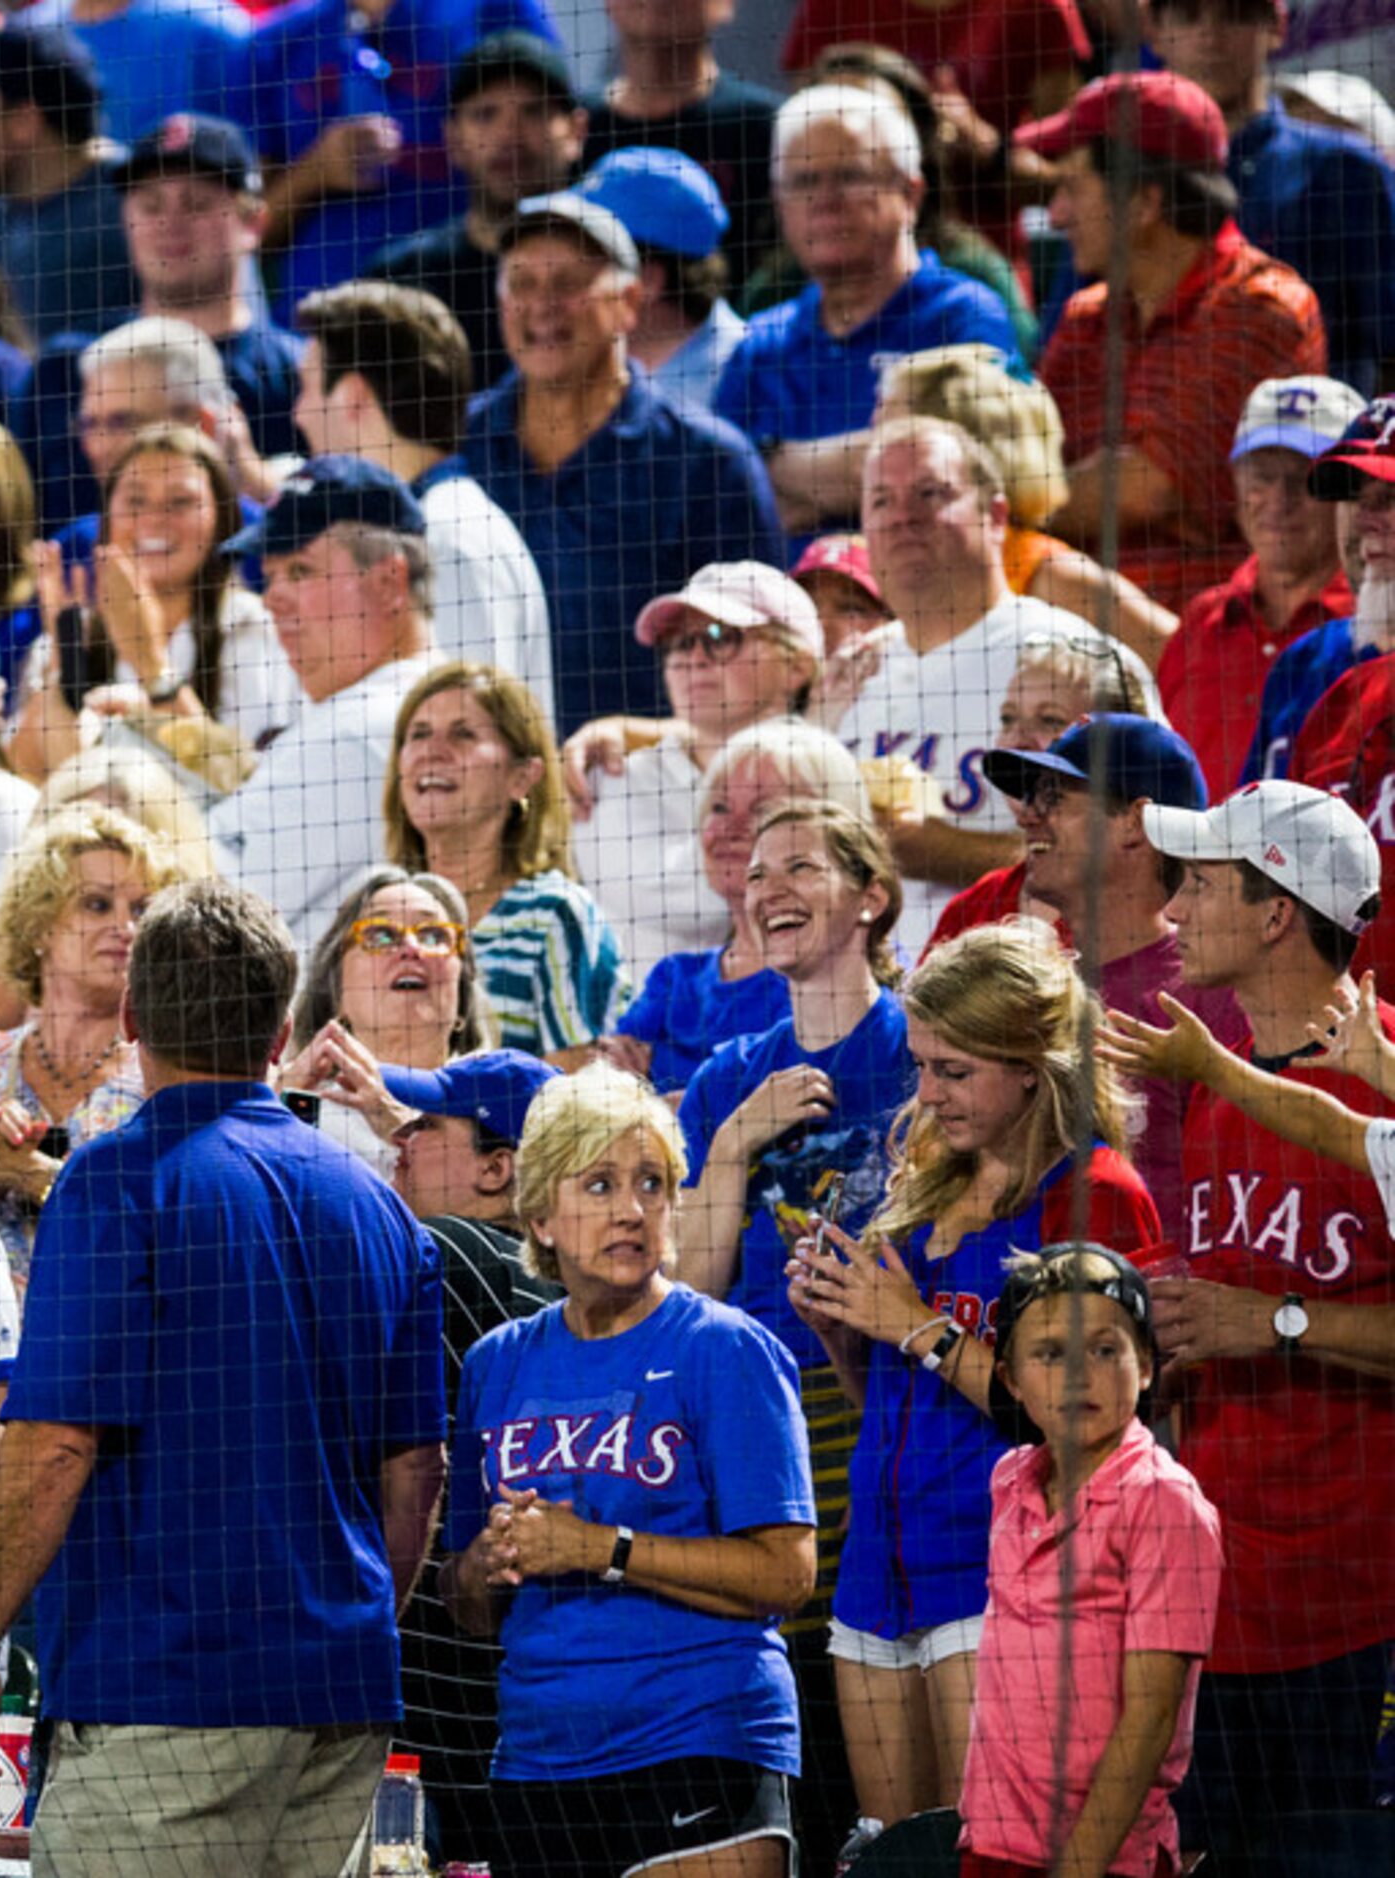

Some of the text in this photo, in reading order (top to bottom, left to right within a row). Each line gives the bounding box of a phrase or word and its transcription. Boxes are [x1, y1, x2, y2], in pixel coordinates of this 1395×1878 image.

[1276, 387, 1318, 419] T
[1184, 1171, 1365, 1282] EXAS
[481, 1412, 687, 1492] EXAS
